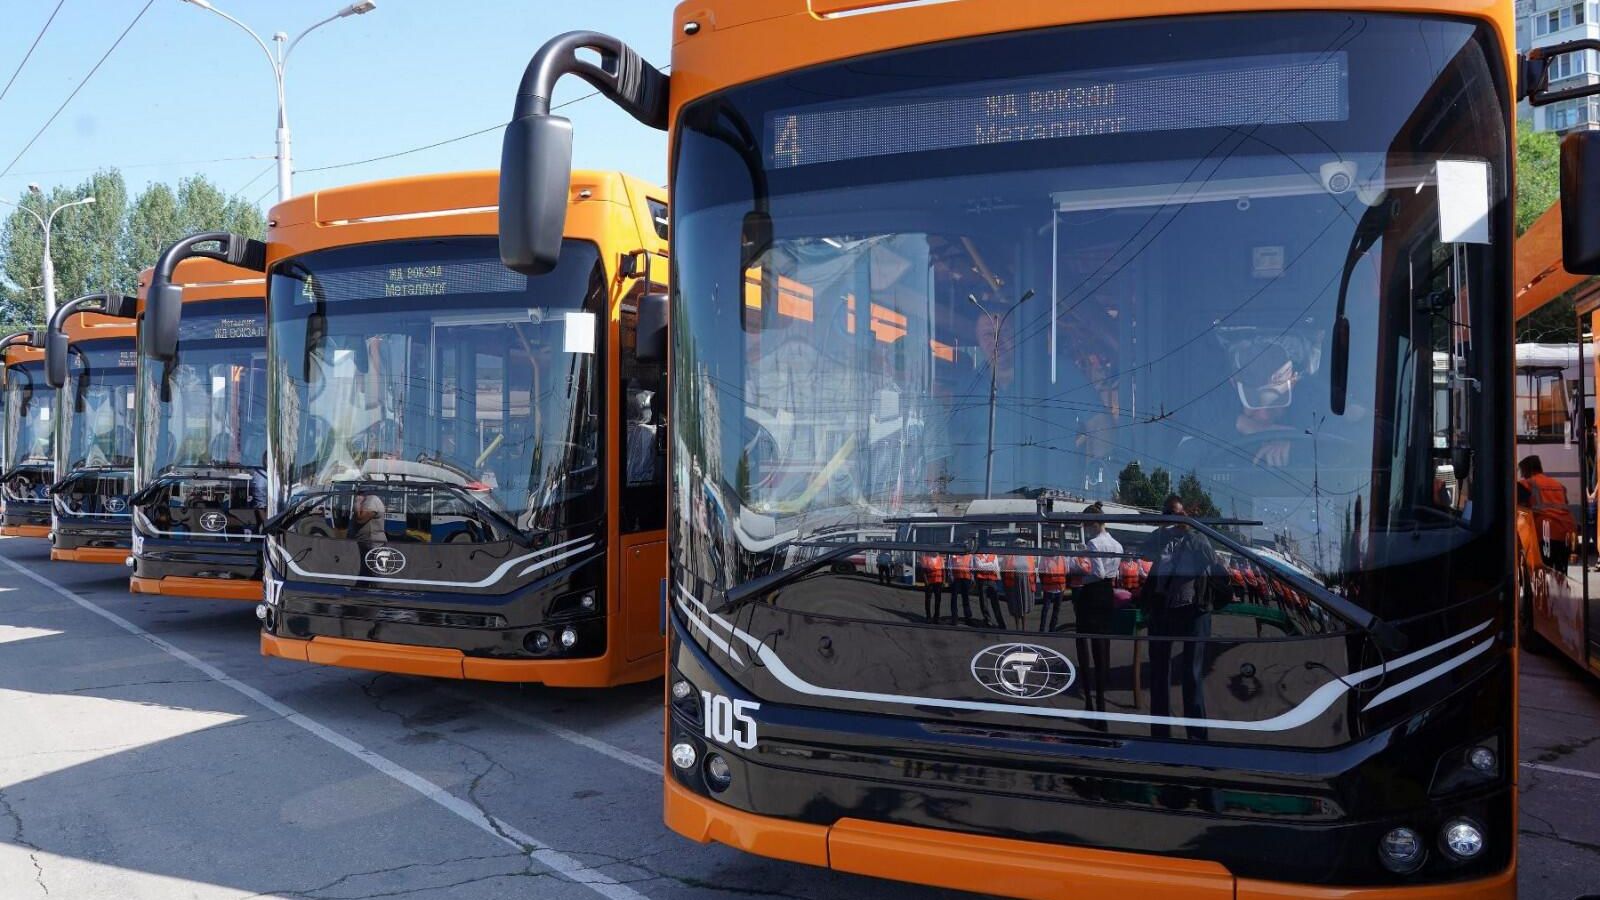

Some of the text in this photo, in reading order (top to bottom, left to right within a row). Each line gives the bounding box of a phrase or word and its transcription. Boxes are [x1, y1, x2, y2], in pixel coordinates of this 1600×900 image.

[985, 84, 1115, 118] ЖД ВОКЗАЛ
[775, 114, 801, 167] 4
[407, 266, 442, 279] ВОКЗАЛ
[302, 274, 315, 303] 4
[385, 281, 446, 297] Металлург
[701, 690, 761, 750] 105
